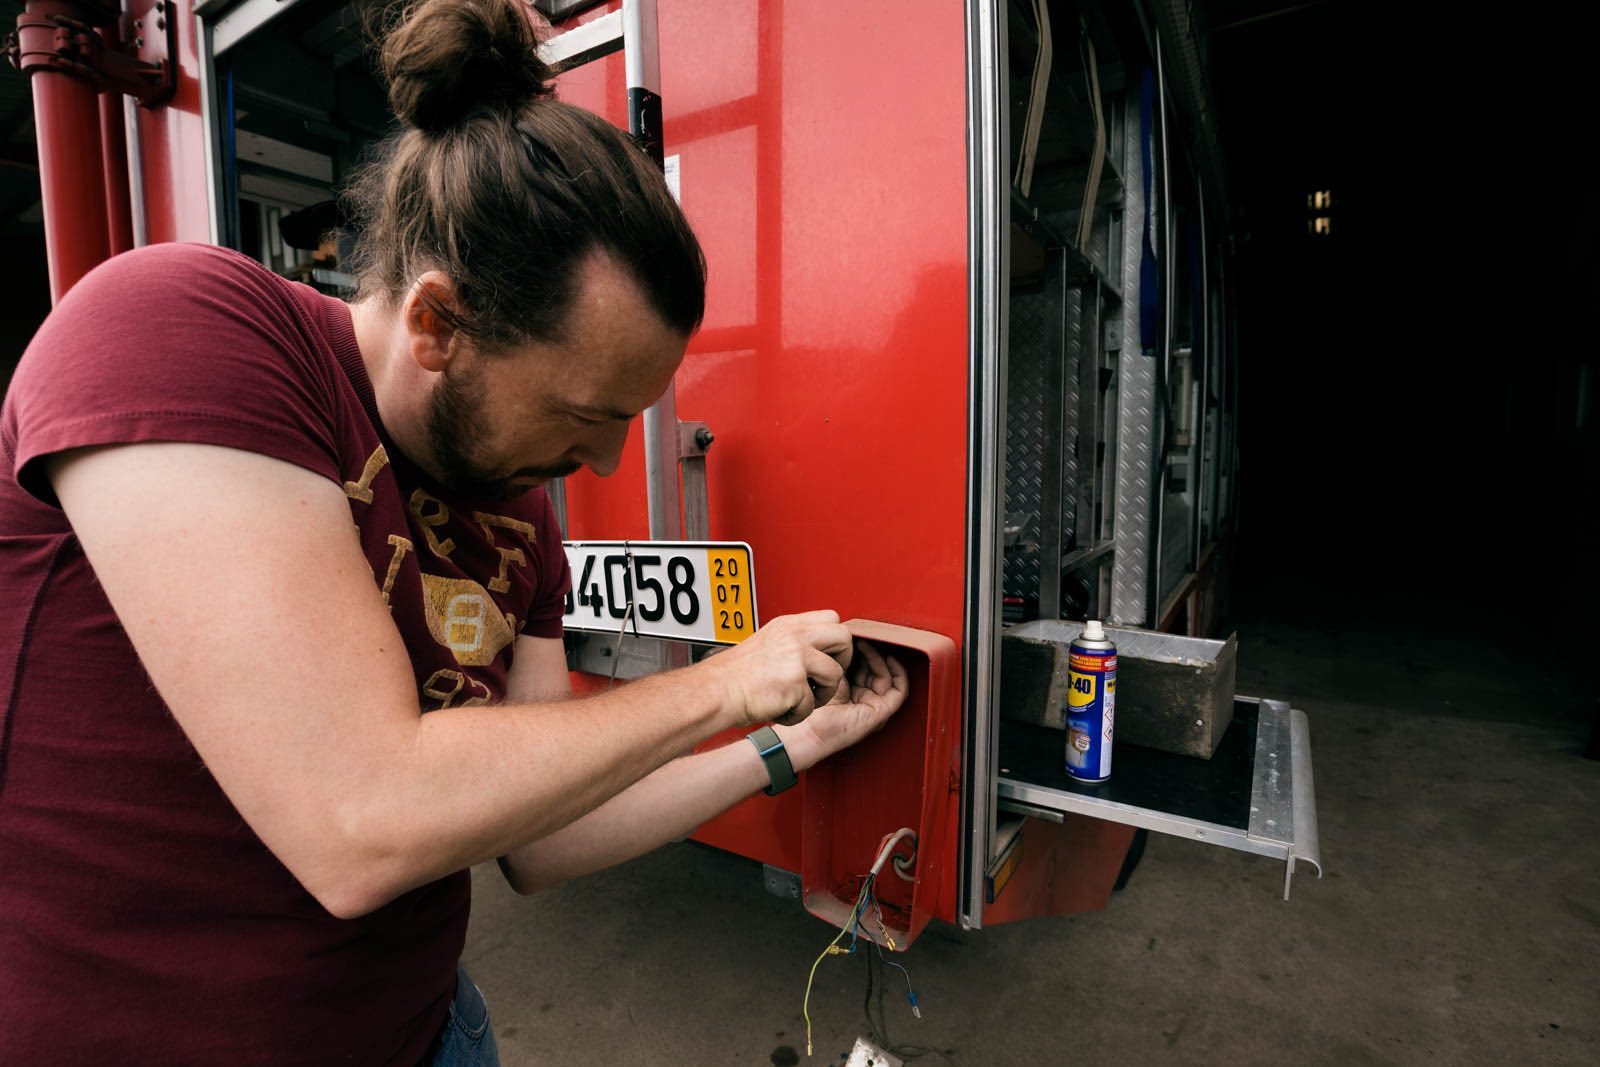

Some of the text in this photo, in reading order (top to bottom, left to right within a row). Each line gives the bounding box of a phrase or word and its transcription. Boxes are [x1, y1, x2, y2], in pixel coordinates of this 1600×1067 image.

[714, 558, 738, 577] 20
[717, 584, 740, 603] 07
[720, 610, 744, 630] 20
